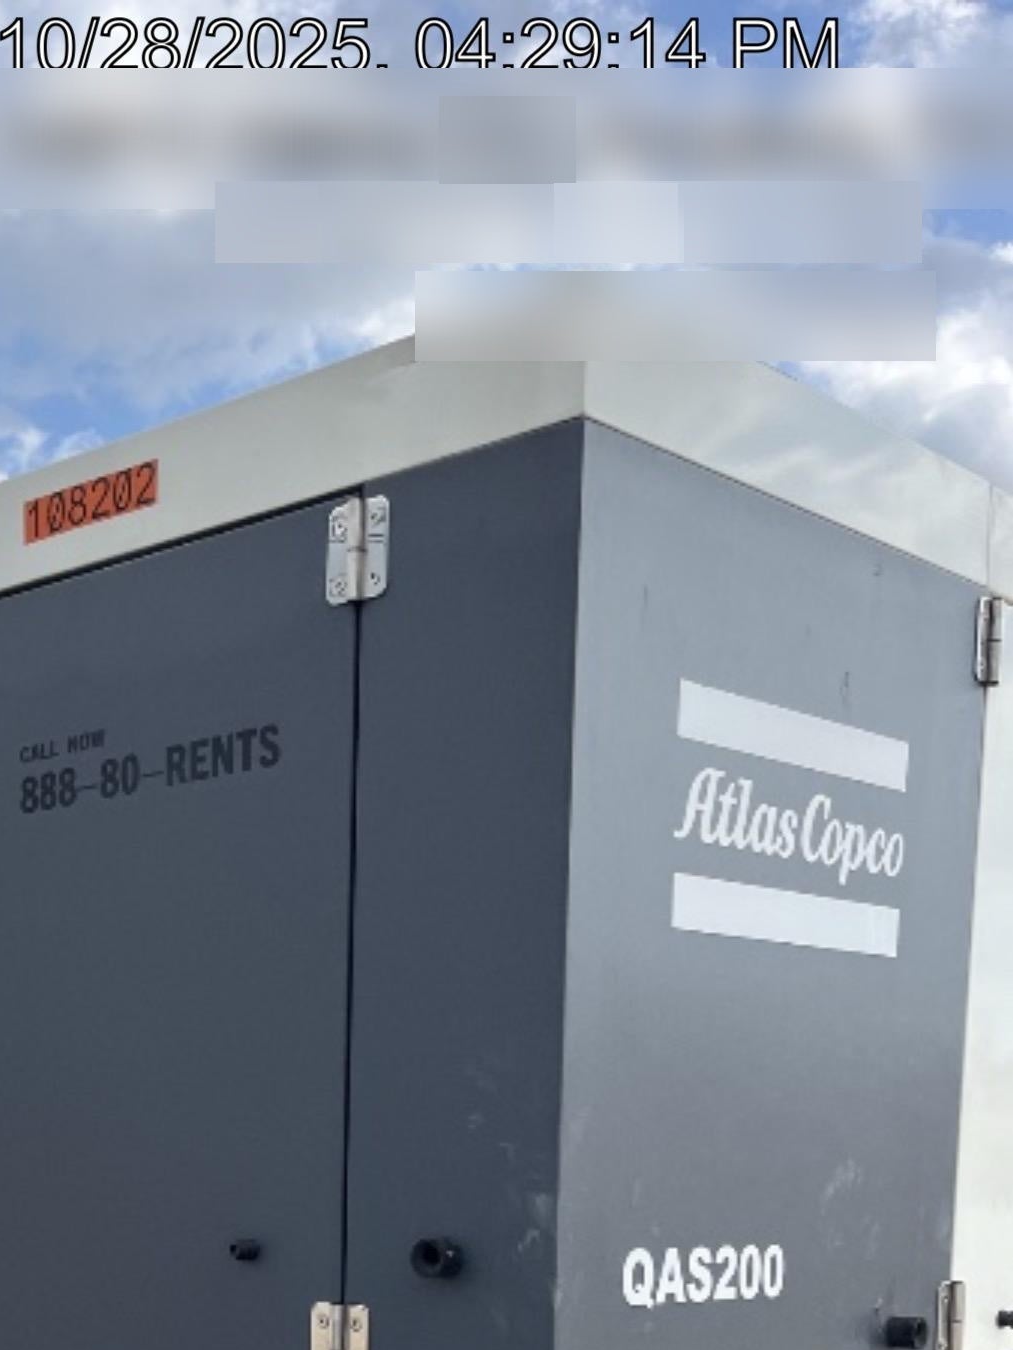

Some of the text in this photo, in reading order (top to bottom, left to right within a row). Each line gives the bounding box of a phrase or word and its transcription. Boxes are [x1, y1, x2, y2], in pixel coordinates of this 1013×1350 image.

[28, 461, 157, 539] 108202
[19, 728, 107, 763] CALL NOW
[19, 723, 282, 814] 888-80-RENTS
[673, 767, 905, 886] Atlas Copco
[622, 1244, 785, 1310] QAS200
